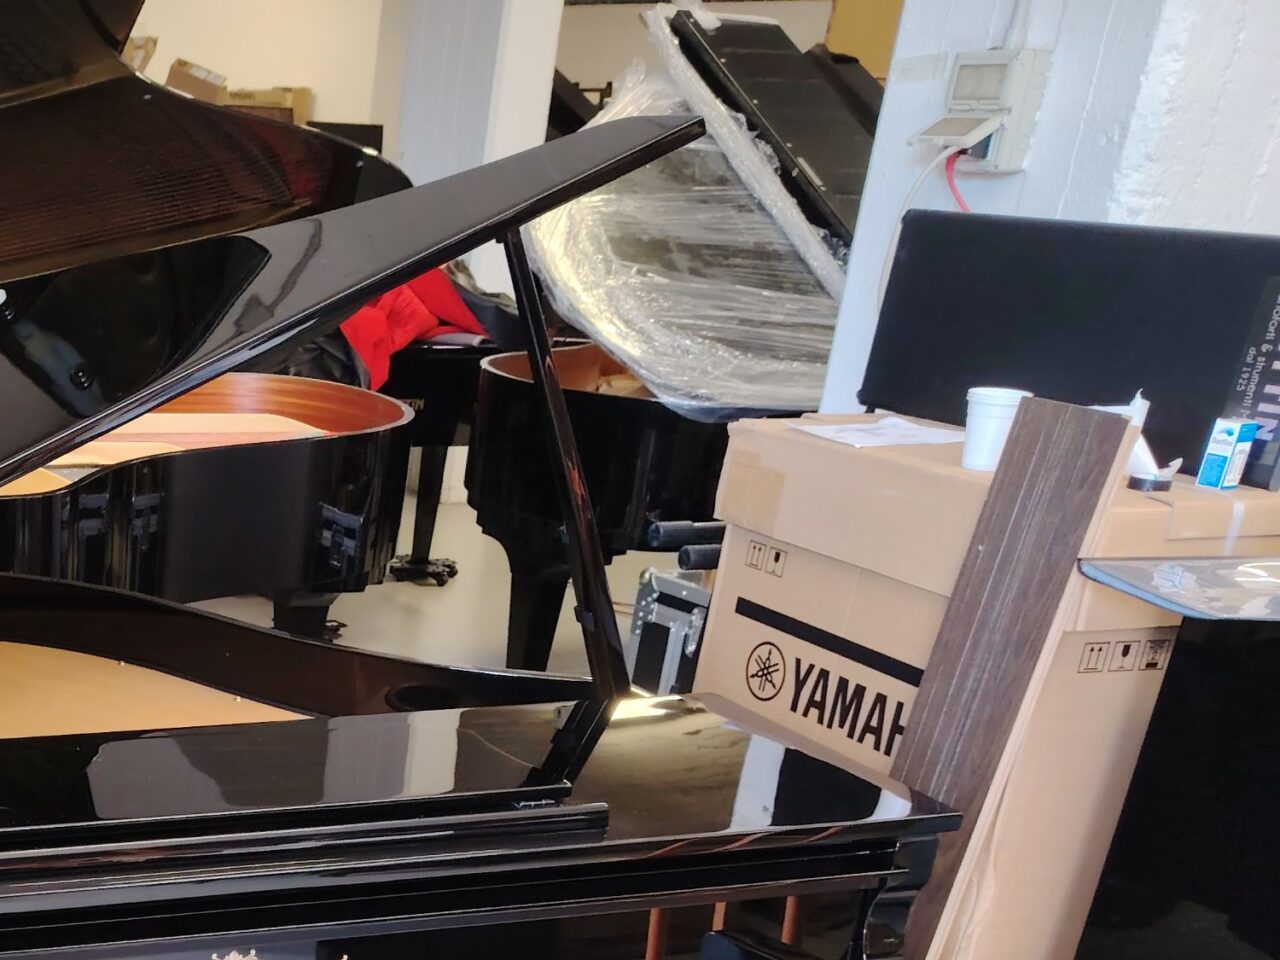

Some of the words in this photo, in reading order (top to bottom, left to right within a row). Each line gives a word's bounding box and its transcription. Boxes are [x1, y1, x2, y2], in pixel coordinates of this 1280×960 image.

[1246, 347, 1256, 363] dal
[1261, 343, 1273, 353] &
[1236, 366, 1251, 391] 1925
[1243, 357, 1266, 406] strumenti
[790, 657, 905, 757] YAMAH
